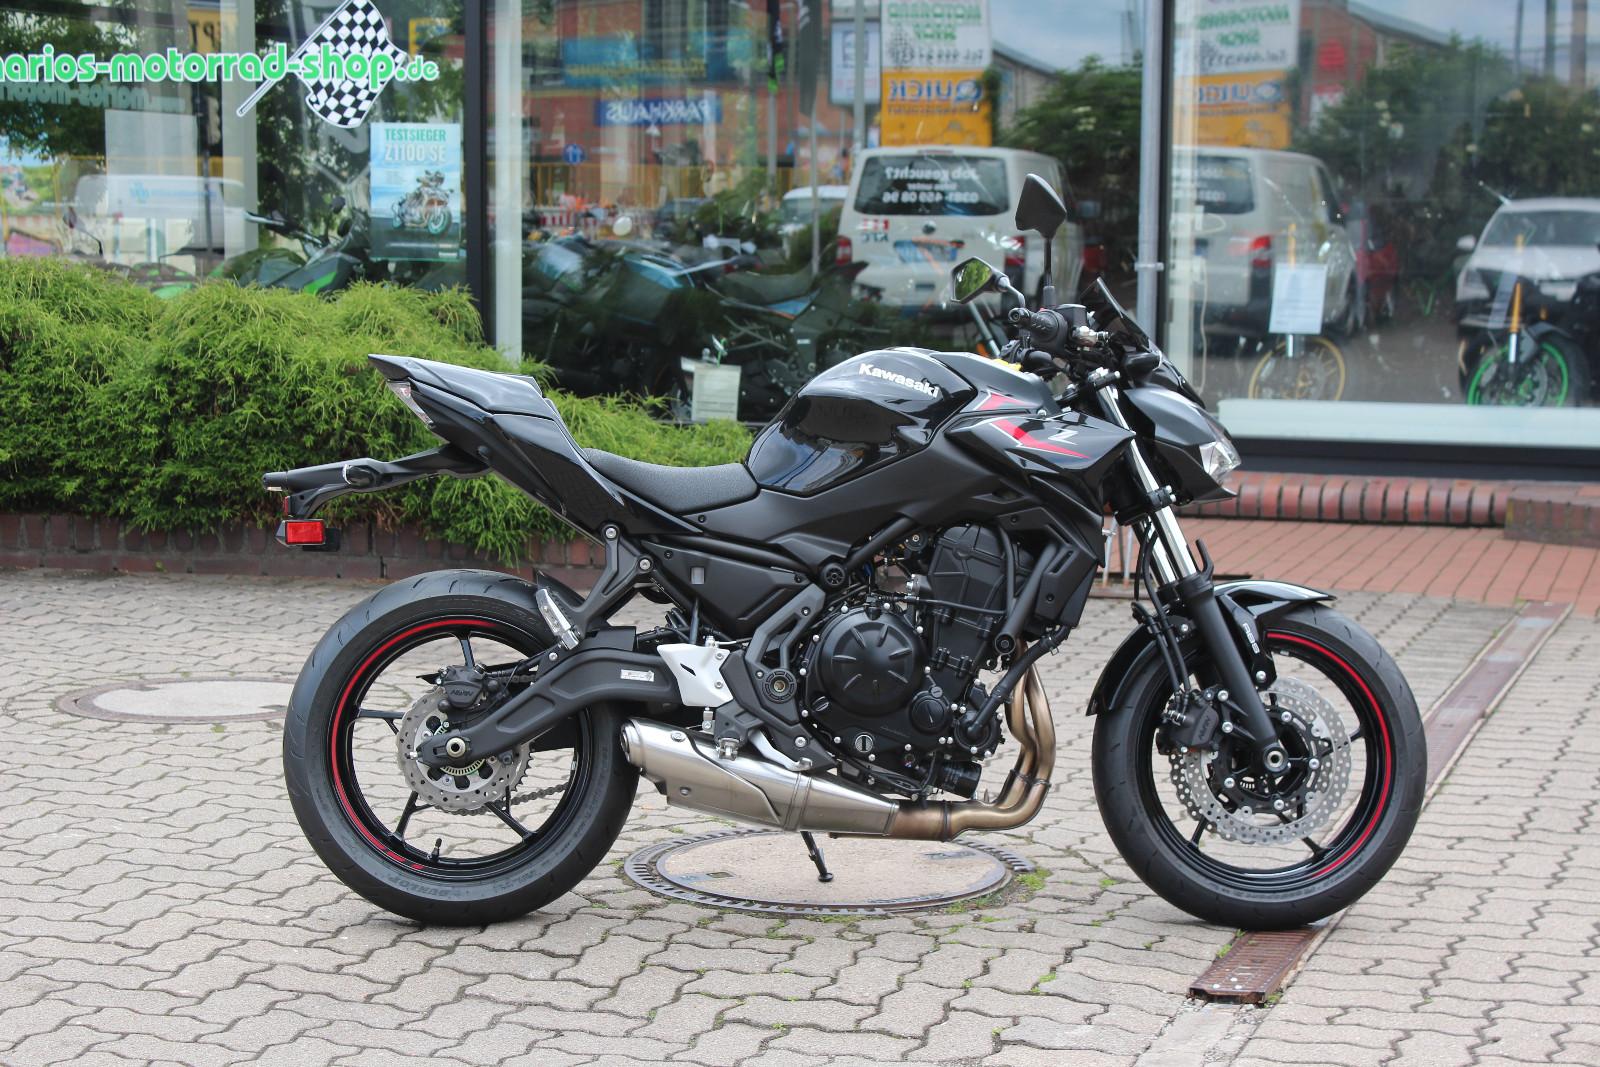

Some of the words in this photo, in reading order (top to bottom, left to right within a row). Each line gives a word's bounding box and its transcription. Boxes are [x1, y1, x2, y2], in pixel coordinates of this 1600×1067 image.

[0, 43, 439, 91] arios-motorrad-shop.de
[385, 128, 447, 142] TESTSIEGER
[385, 144, 425, 161] Z1100
[428, 144, 446, 161] SE
[858, 362, 940, 399] Kawasaki
[1242, 622, 1261, 655] ABS
